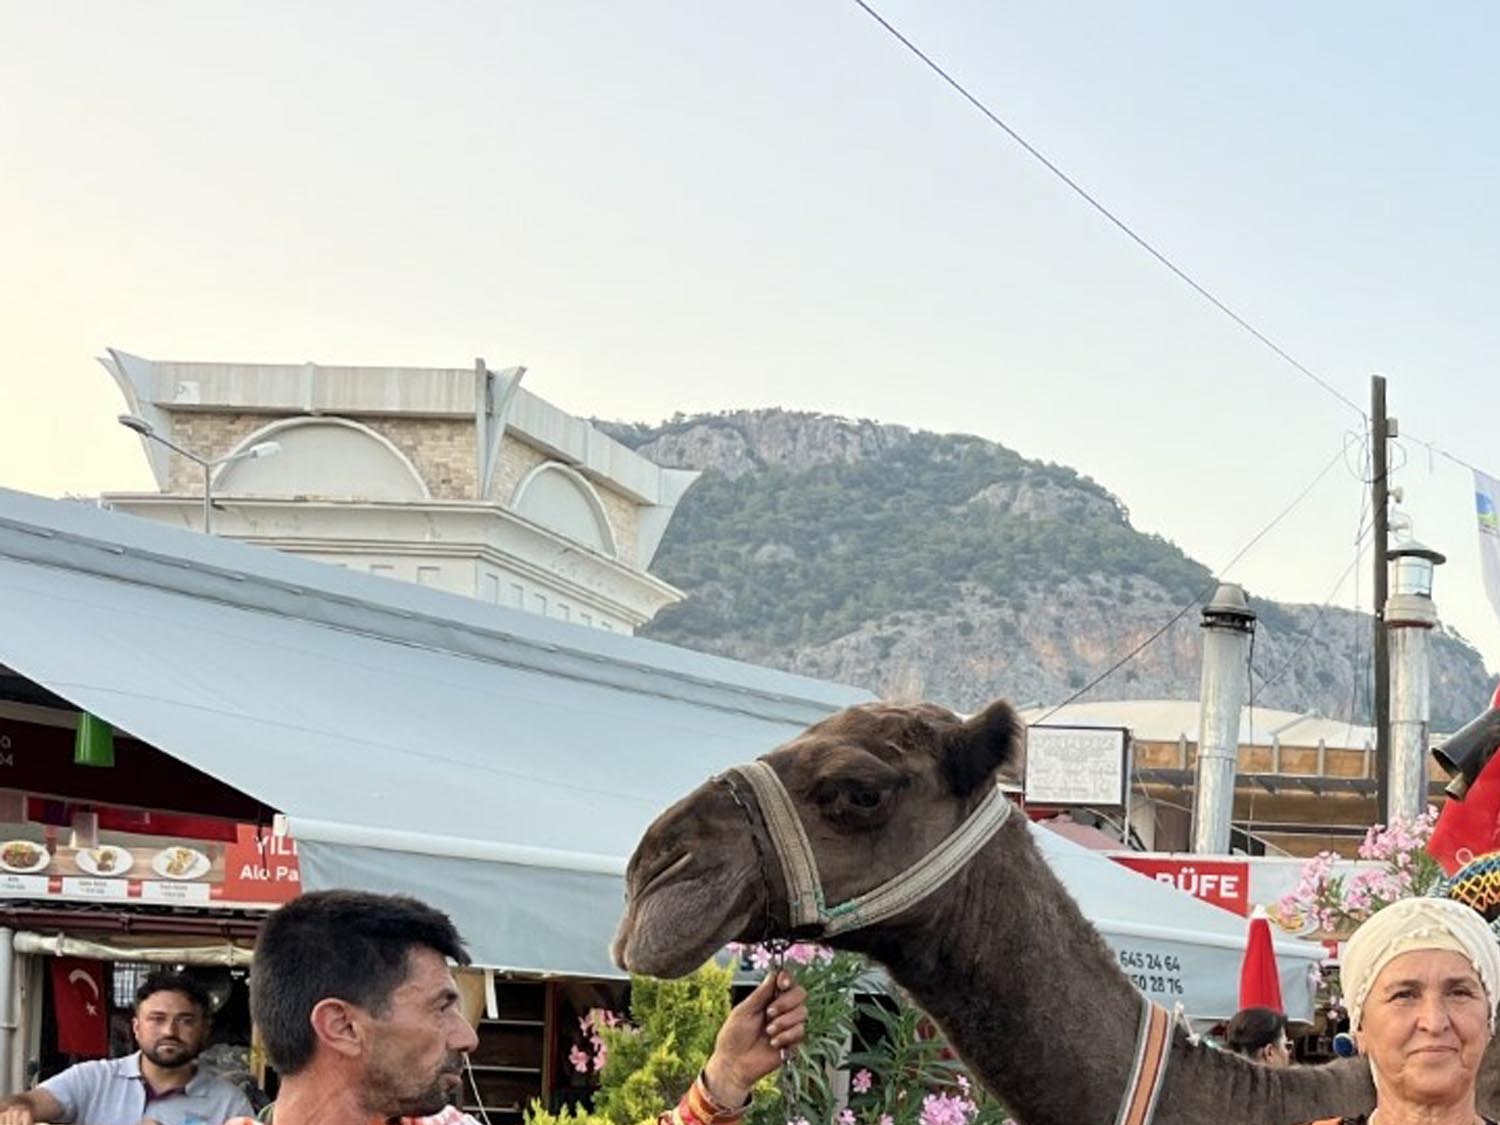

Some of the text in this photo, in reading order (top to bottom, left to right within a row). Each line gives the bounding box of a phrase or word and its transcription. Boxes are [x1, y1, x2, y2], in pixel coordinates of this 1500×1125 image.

[240, 863, 270, 880] Alo
[1120, 950, 1145, 969] 645
[1145, 953, 1162, 970] 24
